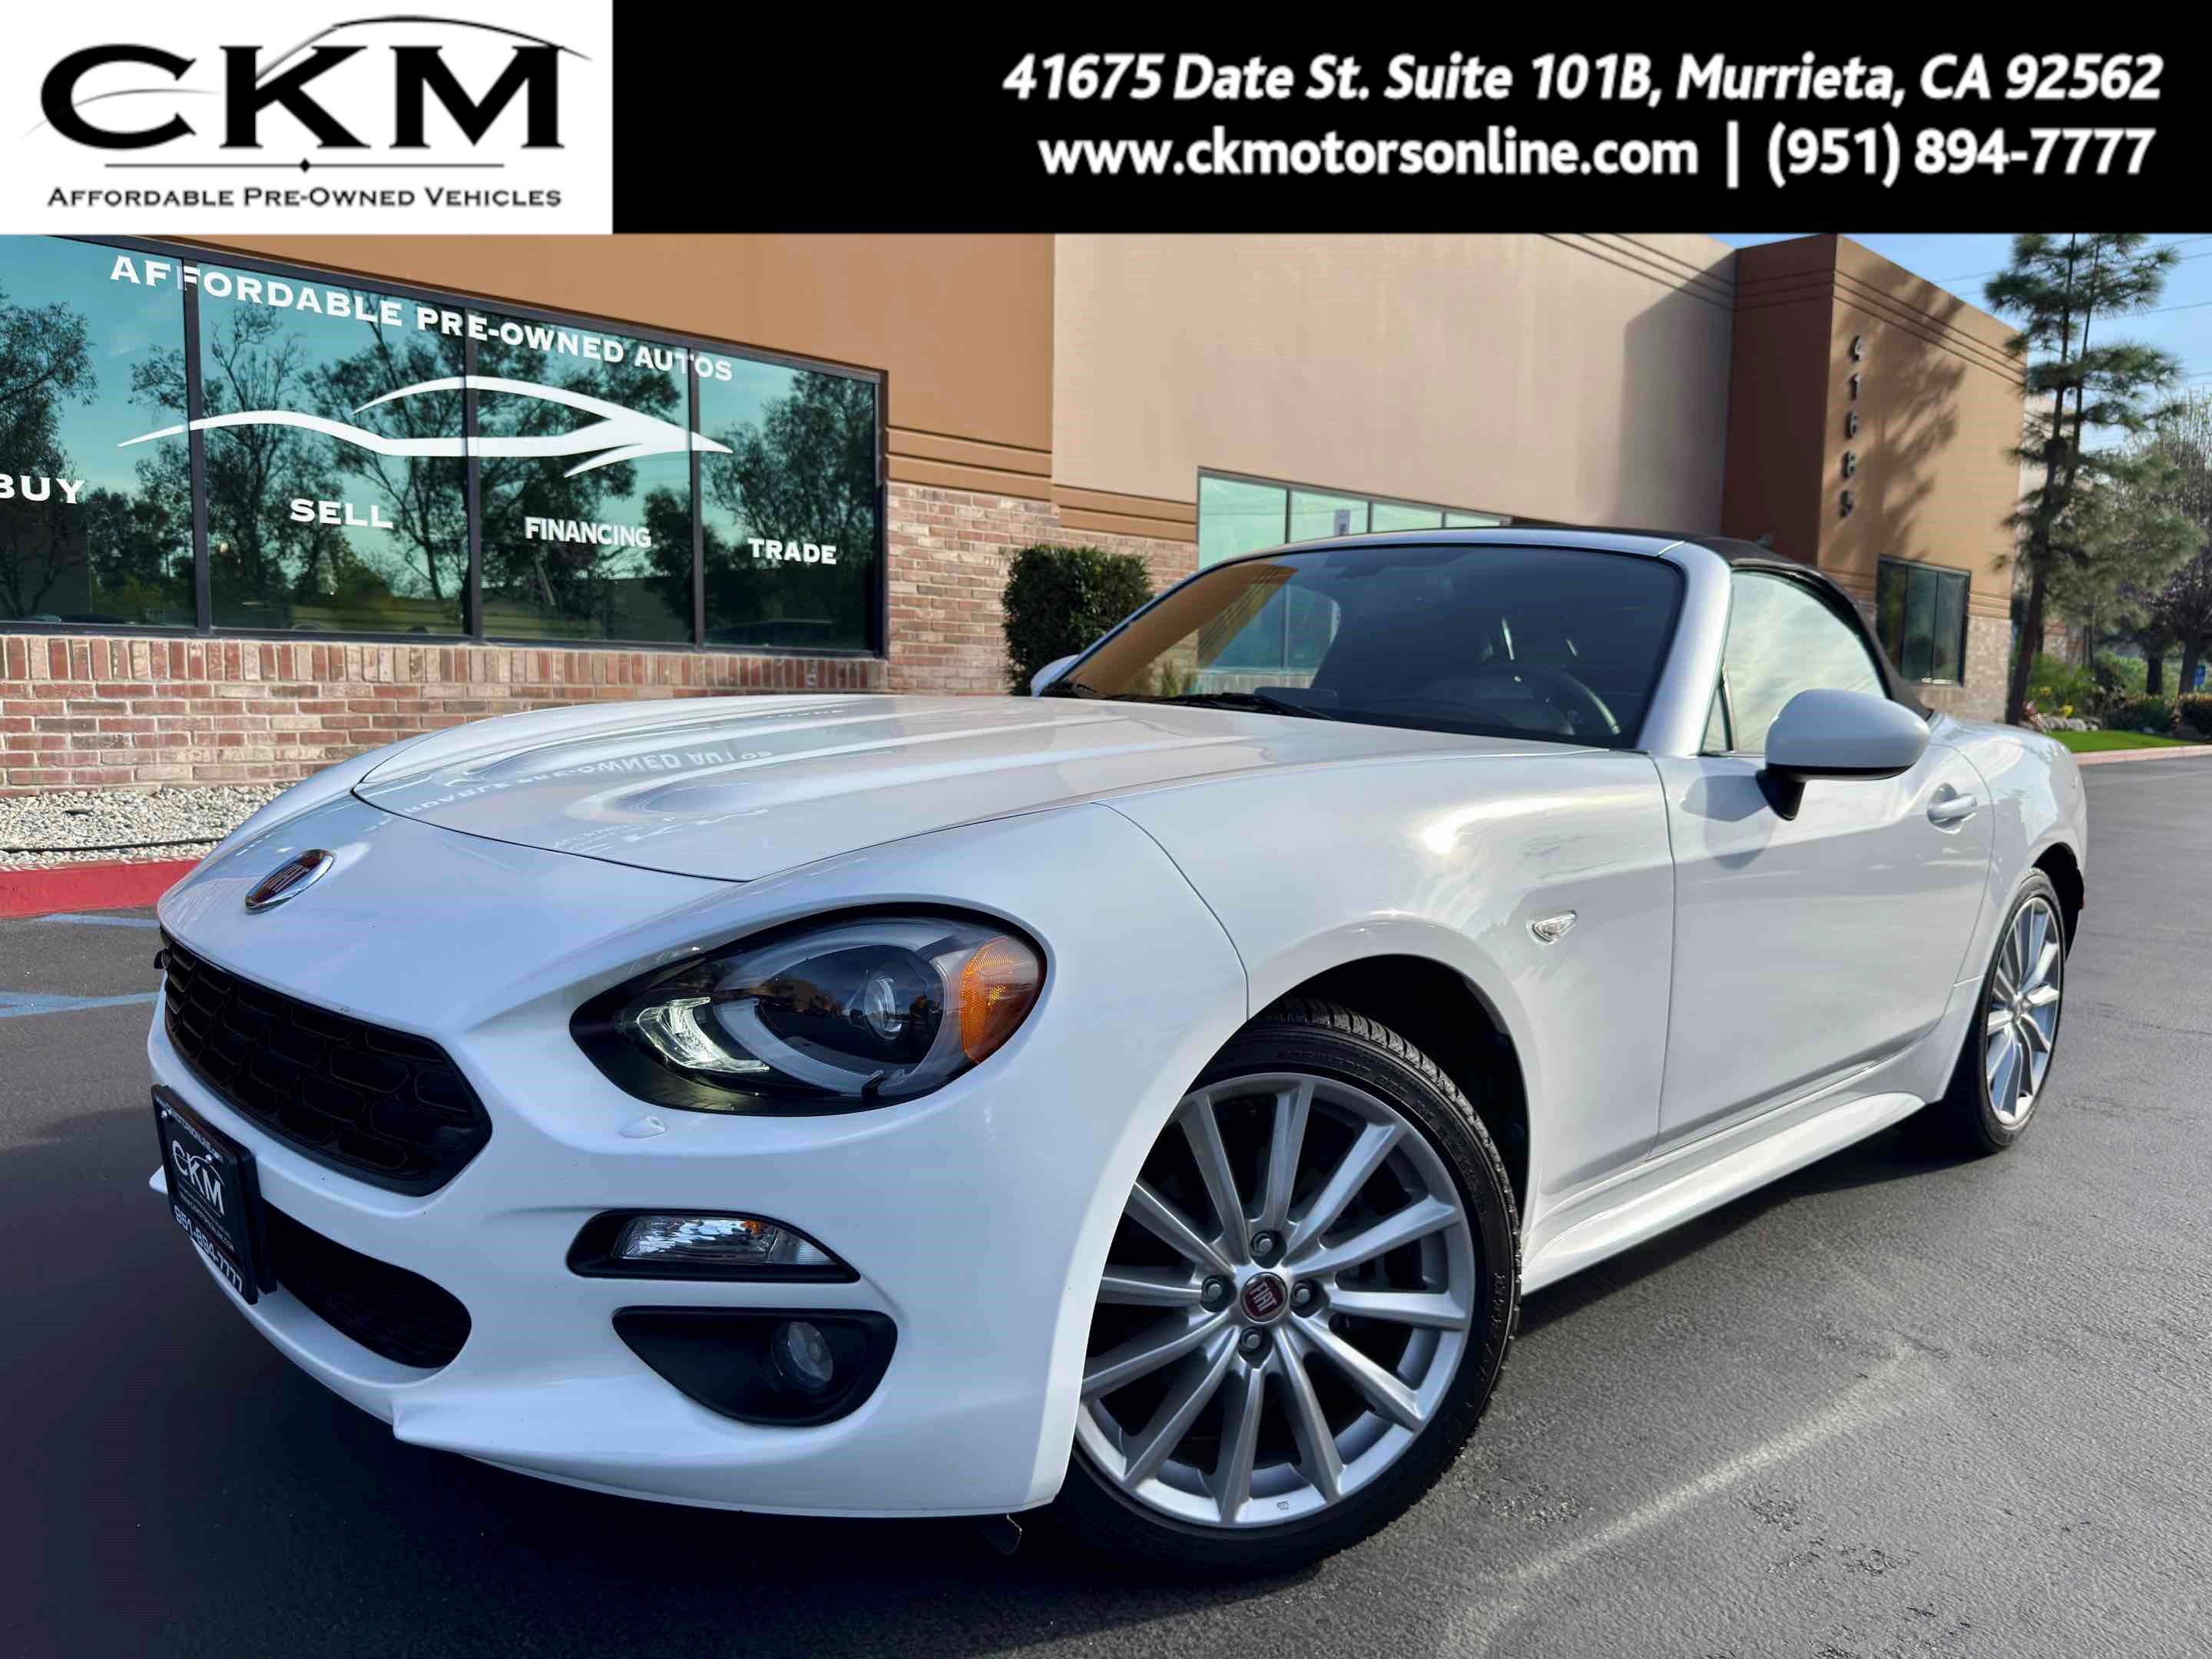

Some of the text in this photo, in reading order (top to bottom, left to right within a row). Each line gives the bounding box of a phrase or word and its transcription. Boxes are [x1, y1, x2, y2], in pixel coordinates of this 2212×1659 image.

[110, 255, 732, 382] AFFORDABLE PRE-OWNED AUTOS
[0, 473, 85, 505] BUY
[290, 498, 394, 529] SELL
[524, 516, 652, 548] FINANCING
[747, 537, 837, 565] TRADE
[171, 1140, 225, 1216] CKM
[1250, 1281, 1277, 1313] FIAT
